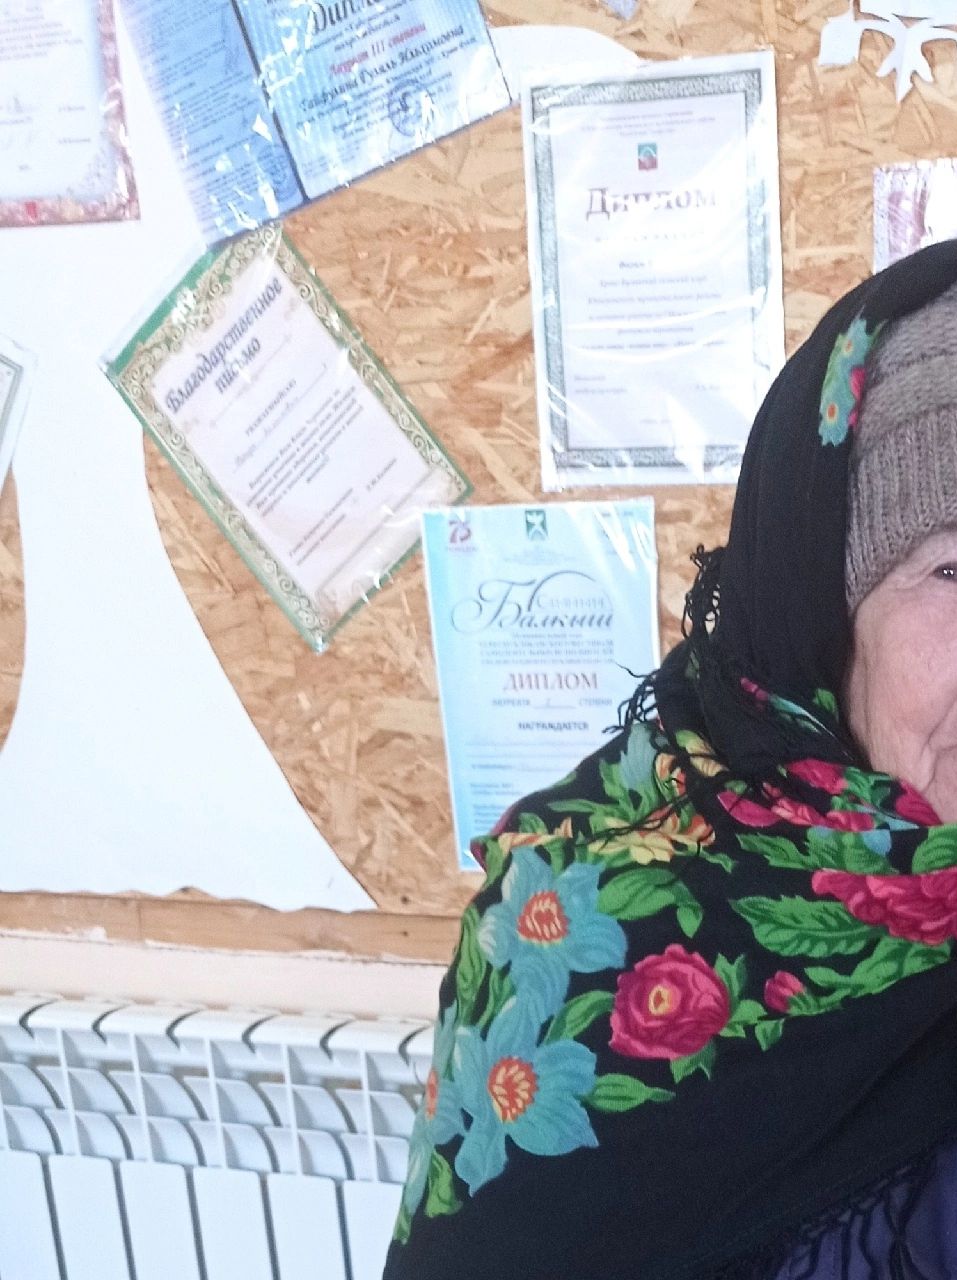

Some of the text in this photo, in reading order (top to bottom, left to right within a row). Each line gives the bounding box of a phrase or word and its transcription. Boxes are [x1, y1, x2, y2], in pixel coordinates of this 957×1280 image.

[165, 277, 282, 414] Благодарственное
[214, 338, 261, 394] письмо
[503, 672, 598, 692] ДИПЛОМ
